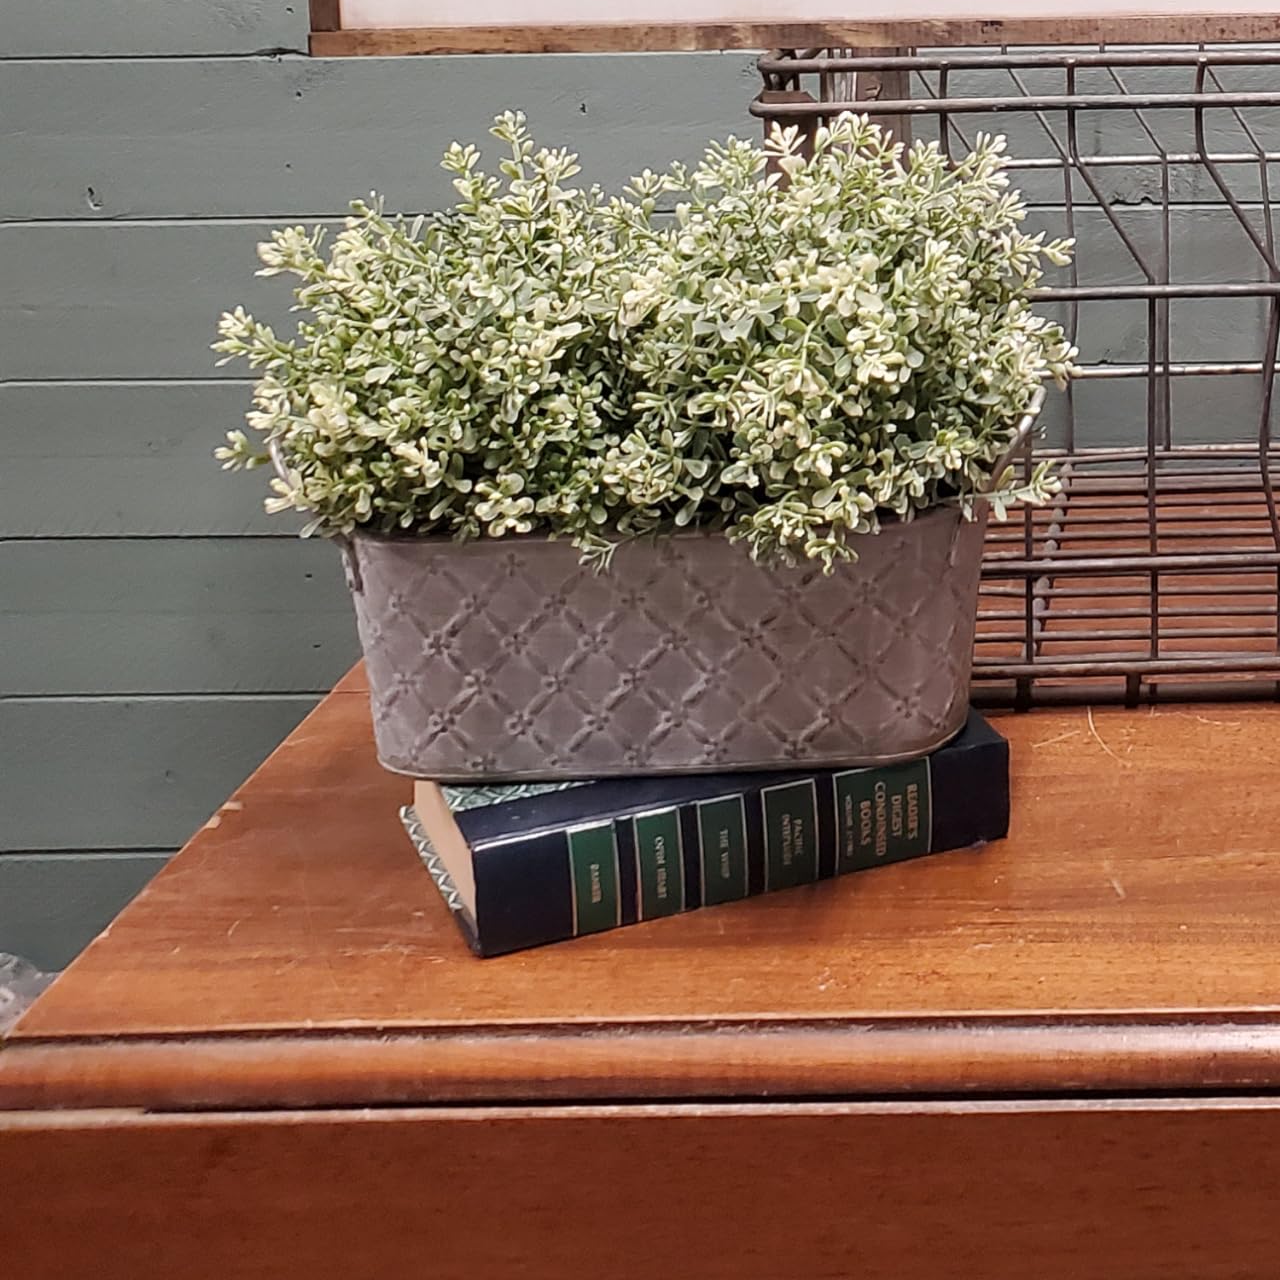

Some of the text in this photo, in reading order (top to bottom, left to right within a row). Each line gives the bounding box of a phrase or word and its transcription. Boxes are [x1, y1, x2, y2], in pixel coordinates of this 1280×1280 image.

[860, 800, 872, 846] BOOKS
[875, 782, 887, 856] CONDENSED
[891, 795, 903, 837] DIGEST
[907, 784, 919, 841] READER'S
[720, 829, 730, 849] THE
